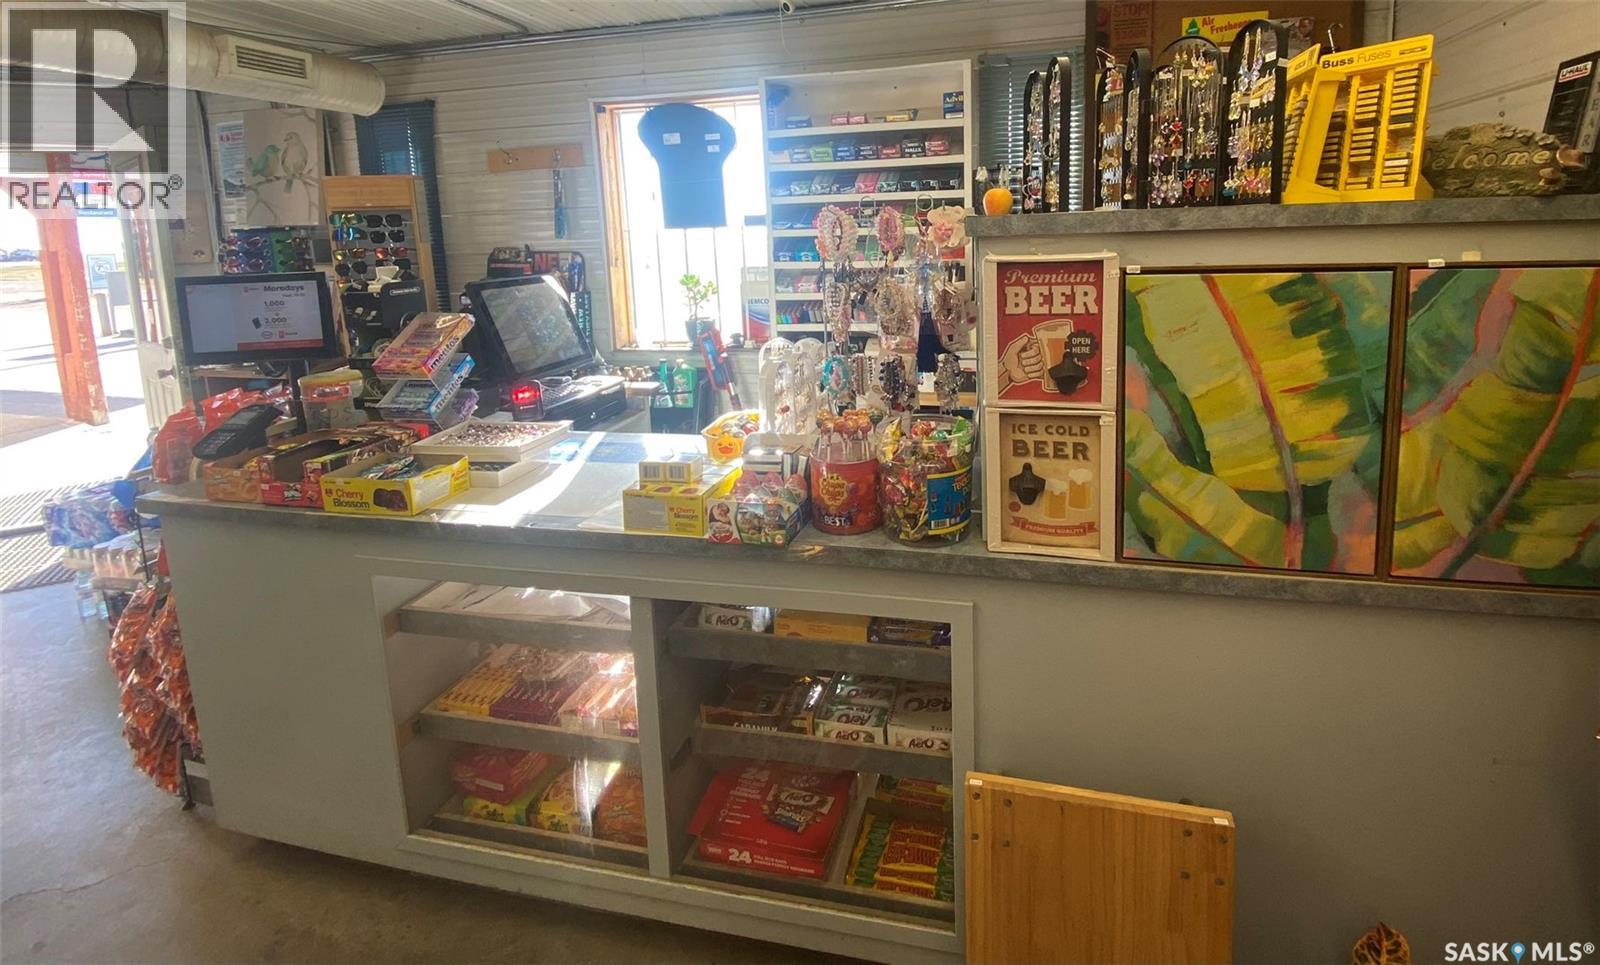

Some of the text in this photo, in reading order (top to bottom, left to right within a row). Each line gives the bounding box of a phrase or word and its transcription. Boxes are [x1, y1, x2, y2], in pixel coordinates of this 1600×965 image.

[1202, 16, 1215, 27] Air
[1322, 56, 1354, 69] Buss
[1356, 49, 1391, 65] Fuses
[1561, 63, 1589, 77] U-HAUL
[945, 95, 964, 104] Advil
[1004, 268, 1097, 285] Premium
[263, 284, 304, 293] Moredays
[1004, 285, 1099, 315] BEER
[1071, 337, 1091, 345] OPEN
[431, 335, 460, 370] mentos
[1071, 346, 1091, 354] HERE
[1011, 423, 1090, 437] ICE COLD
[1011, 439, 1090, 461] BEER
[335, 488, 364, 500] Cherry
[333, 498, 370, 509] Blossom
[824, 516, 846, 527] BEST
[728, 848, 752, 864] 24
